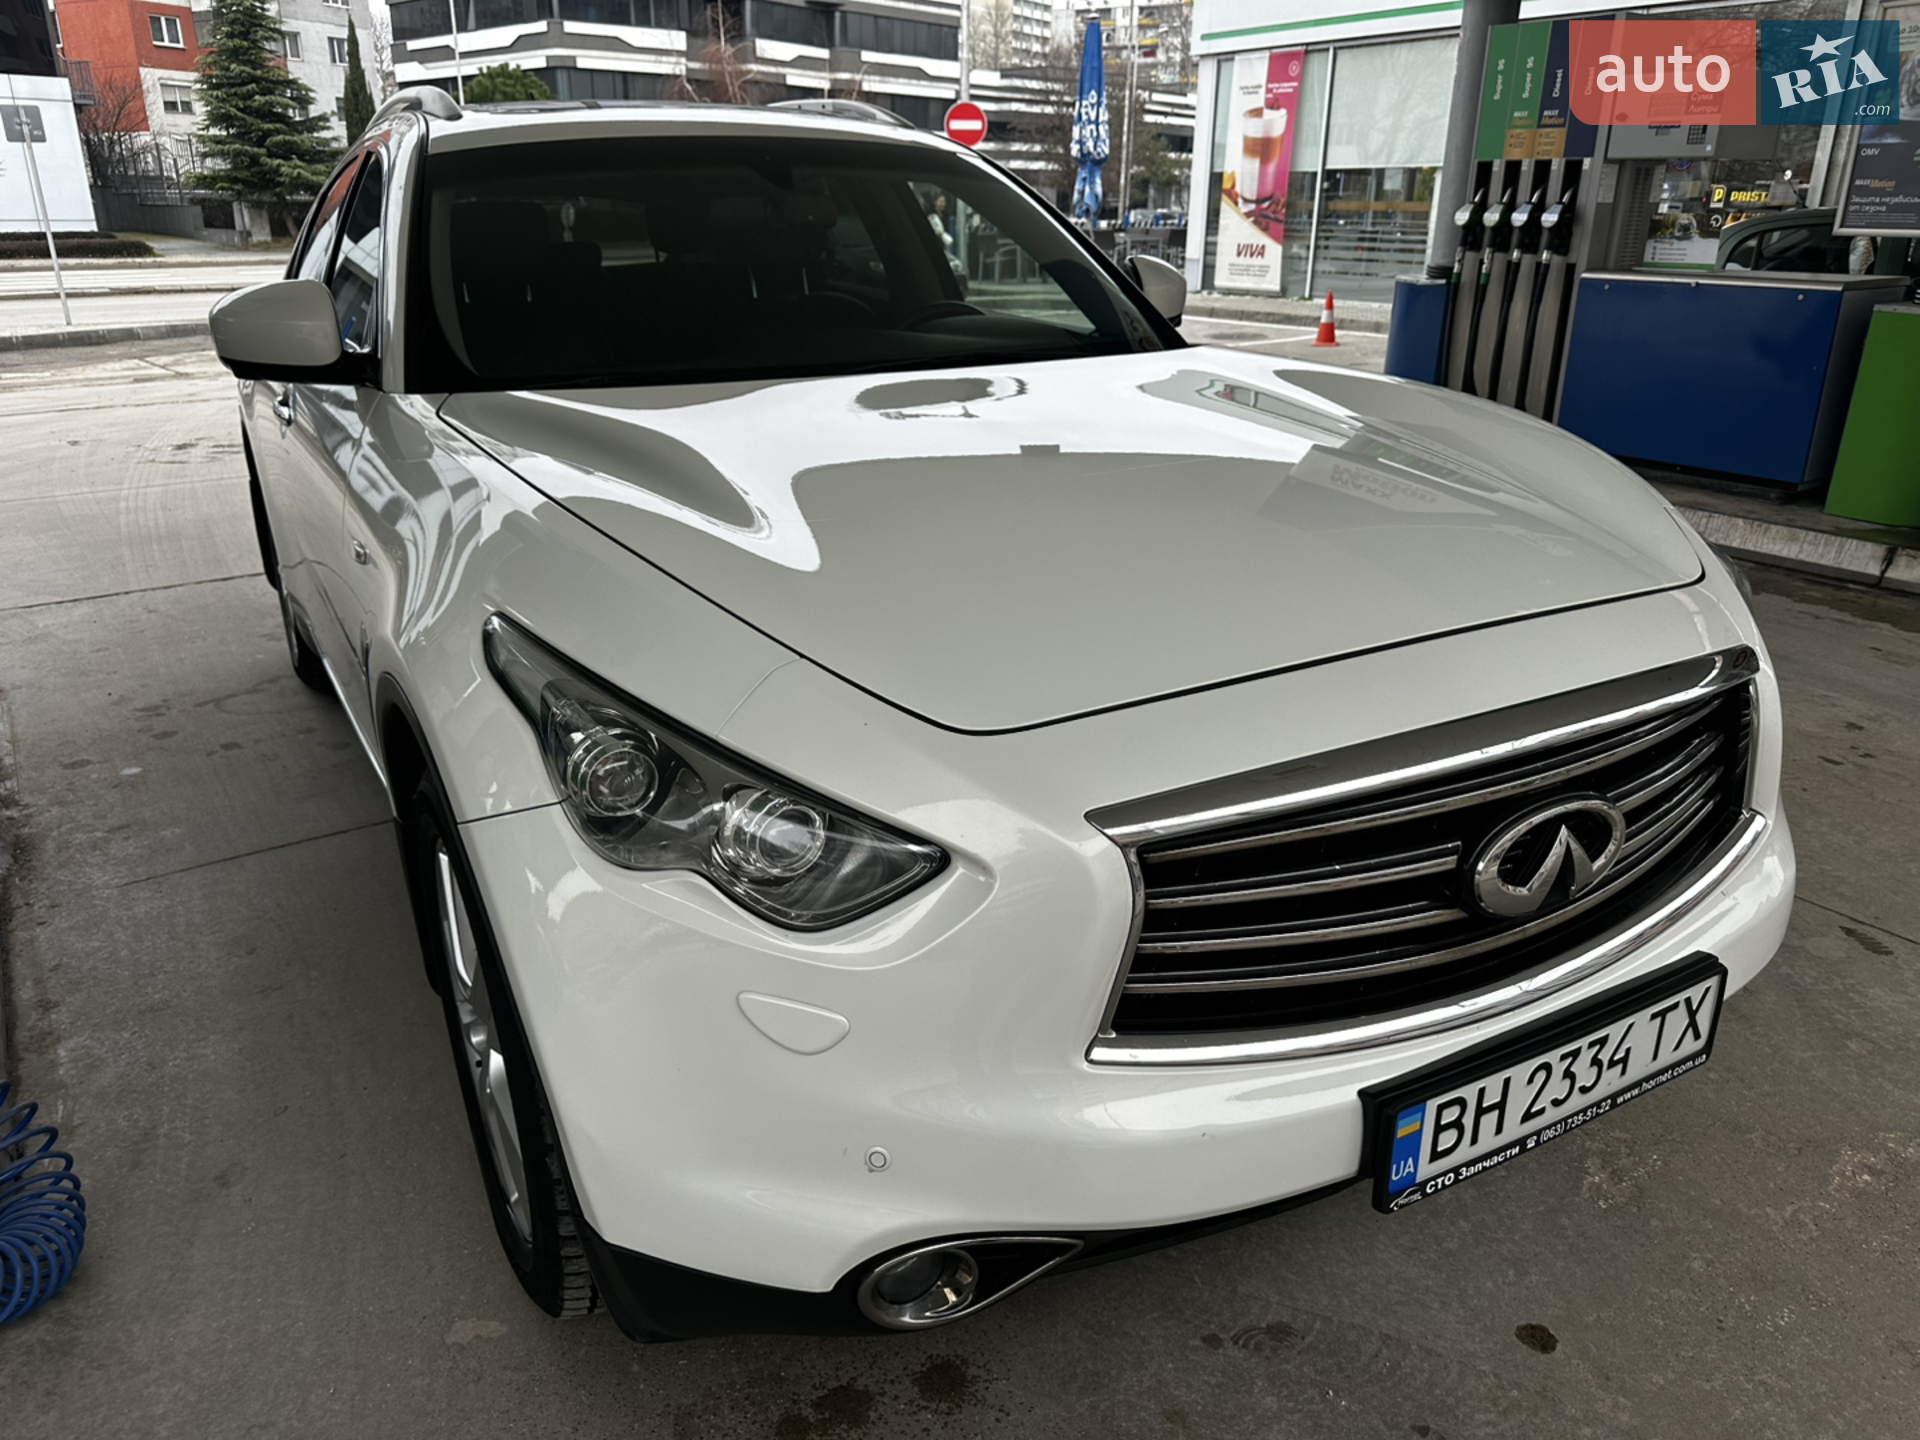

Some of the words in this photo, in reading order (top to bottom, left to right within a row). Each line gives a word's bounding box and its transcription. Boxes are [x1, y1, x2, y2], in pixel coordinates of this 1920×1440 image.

[1552, 69, 1563, 97] Diesel
[1860, 147, 1880, 156] OMV
[1729, 190, 1768, 203] PRIST
[1861, 205, 1887, 213] сезона
[1236, 243, 1266, 259] VIVA
[1429, 1076, 1512, 1165] BH
[1519, 1022, 1634, 1125] 2334
[1649, 985, 1712, 1063] TX
[1425, 1172, 1455, 1194] СТО
[1458, 1145, 1520, 1180] Запчасти
[1539, 1121, 1566, 1144] (063)
[1566, 1099, 1612, 1130] 735-51-22
[1616, 1053, 1707, 1105] www.hornet.com.ua
[1391, 1156, 1415, 1181] UA
